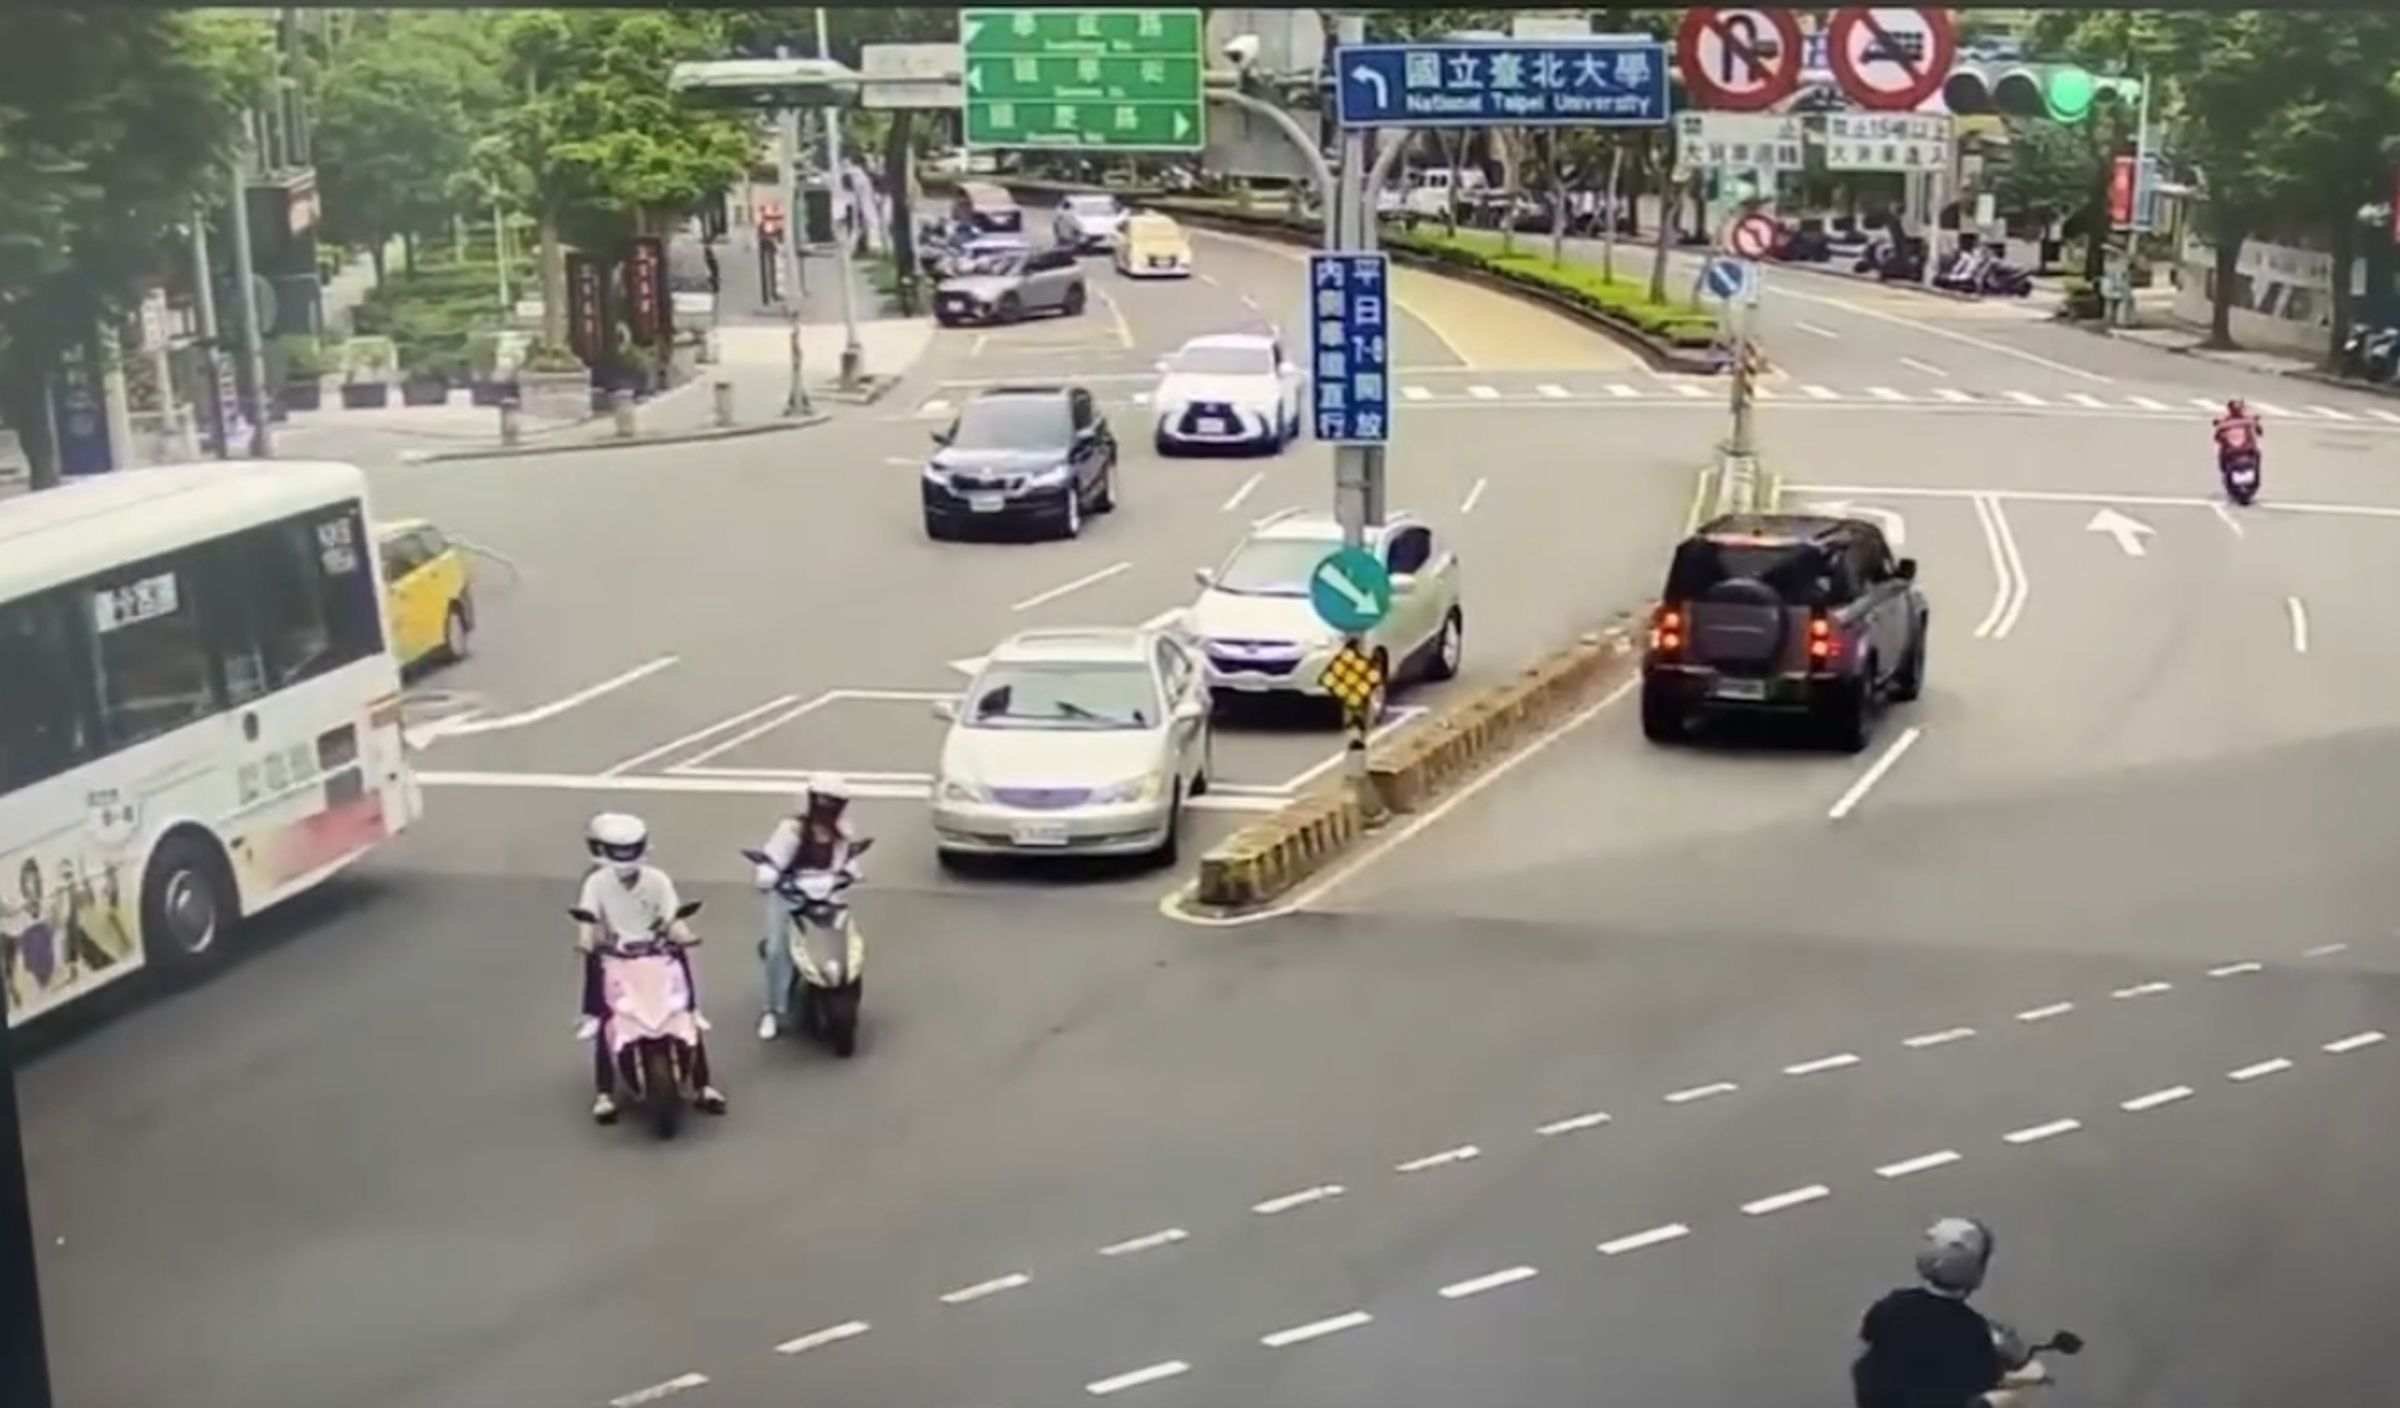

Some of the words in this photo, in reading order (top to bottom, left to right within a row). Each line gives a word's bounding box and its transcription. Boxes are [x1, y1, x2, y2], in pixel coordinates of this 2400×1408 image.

[1405, 51, 1651, 89] 國立臺北大學
[1406, 93, 1483, 112] National
[1491, 93, 1546, 113] Taipei
[1553, 93, 1651, 113] University
